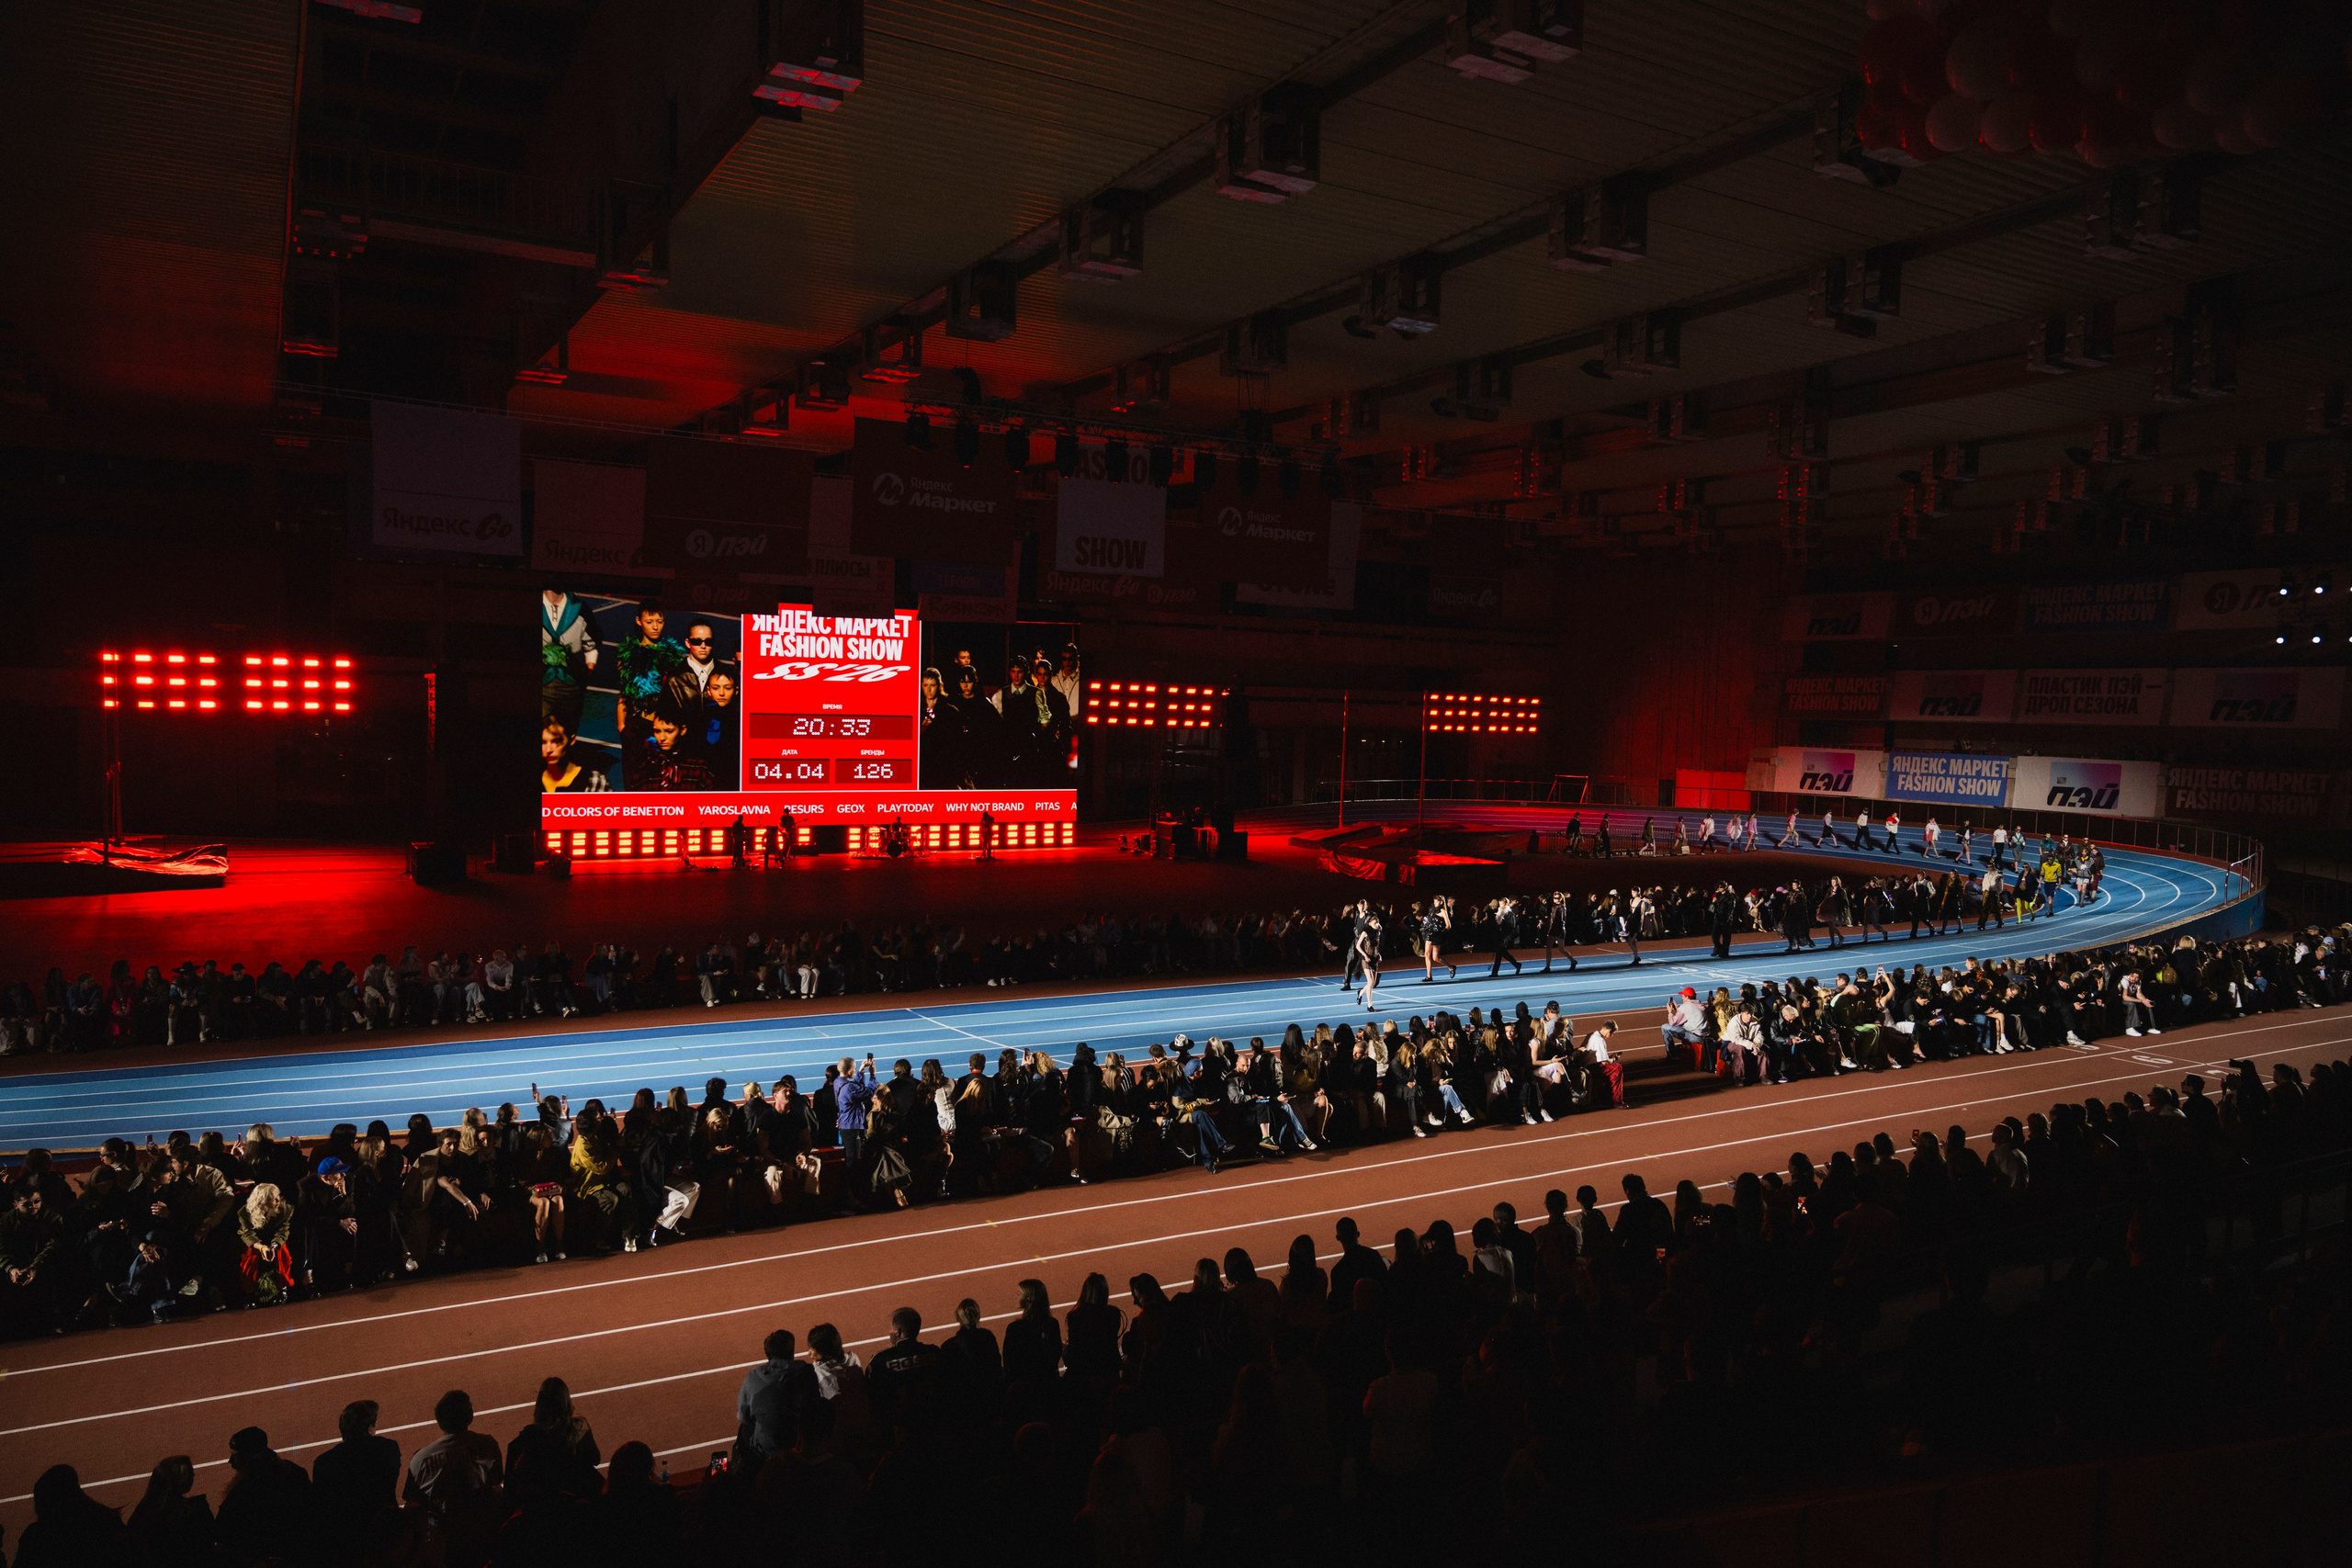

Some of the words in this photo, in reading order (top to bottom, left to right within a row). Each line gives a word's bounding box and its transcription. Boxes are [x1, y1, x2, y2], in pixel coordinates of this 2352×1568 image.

[910, 477, 954, 493] Яндекс
[909, 491, 997, 513] Маркет
[382, 507, 470, 536] Яндекс
[475, 513, 513, 540] Go
[1247, 511, 1282, 524] Яндекс
[1245, 524, 1316, 543] Маркет
[544, 540, 625, 564] Яндекс
[1075, 536, 1147, 569] SHOW
[1046, 571, 1111, 594] Яндекс
[2029, 584, 2094, 606] ЯНДЕКС
[2095, 581, 2168, 603] МАРКЕТ
[1432, 587, 1477, 606] Яндекс
[2033, 604, 2104, 625] FASHION
[2105, 602, 2158, 622] SHOW
[835, 615, 912, 637] МАРКЕТ
[760, 634, 843, 659] FASHION
[846, 637, 903, 660] SHOW
[1785, 678, 1833, 694] ЯНДЕКС
[1834, 677, 1886, 694] МАРКЕТ
[2028, 676, 2102, 694] ПЛАСТИК
[2107, 673, 2143, 694] ПЭЙ
[1788, 694, 1840, 711] FASHION
[1841, 694, 1881, 711] SHOW
[2025, 696, 2070, 715] ДРОП
[2075, 695, 2139, 715] СЕЗОНА
[793, 718, 871, 736] 20:33
[754, 763, 824, 779] 04.04
[854, 763, 894, 779] 126
[1892, 756, 1947, 777] ЯНДЕКС
[1949, 758, 2009, 778] МАРКЕТ
[1897, 773, 1958, 795] FASHION
[1958, 778, 2002, 797] SHOW
[2167, 768, 2243, 791] ЯНДЕКС
[2245, 771, 2330, 795] МАРКЕТ
[553, 807, 602, 818] COLORS
[604, 807, 620, 818] OF
[622, 806, 684, 817] BENETTON
[698, 805, 771, 816] YAROSLAVNA
[836, 804, 865, 814] GEOX
[876, 803, 934, 813] PLAYTODAY
[945, 803, 968, 813] WHY
[970, 802, 990, 812] NOT
[991, 802, 1024, 812] BRAND
[1035, 802, 1060, 811] PITAS
[2175, 788, 2256, 813] FASHION
[2258, 794, 2319, 817] SHOW
